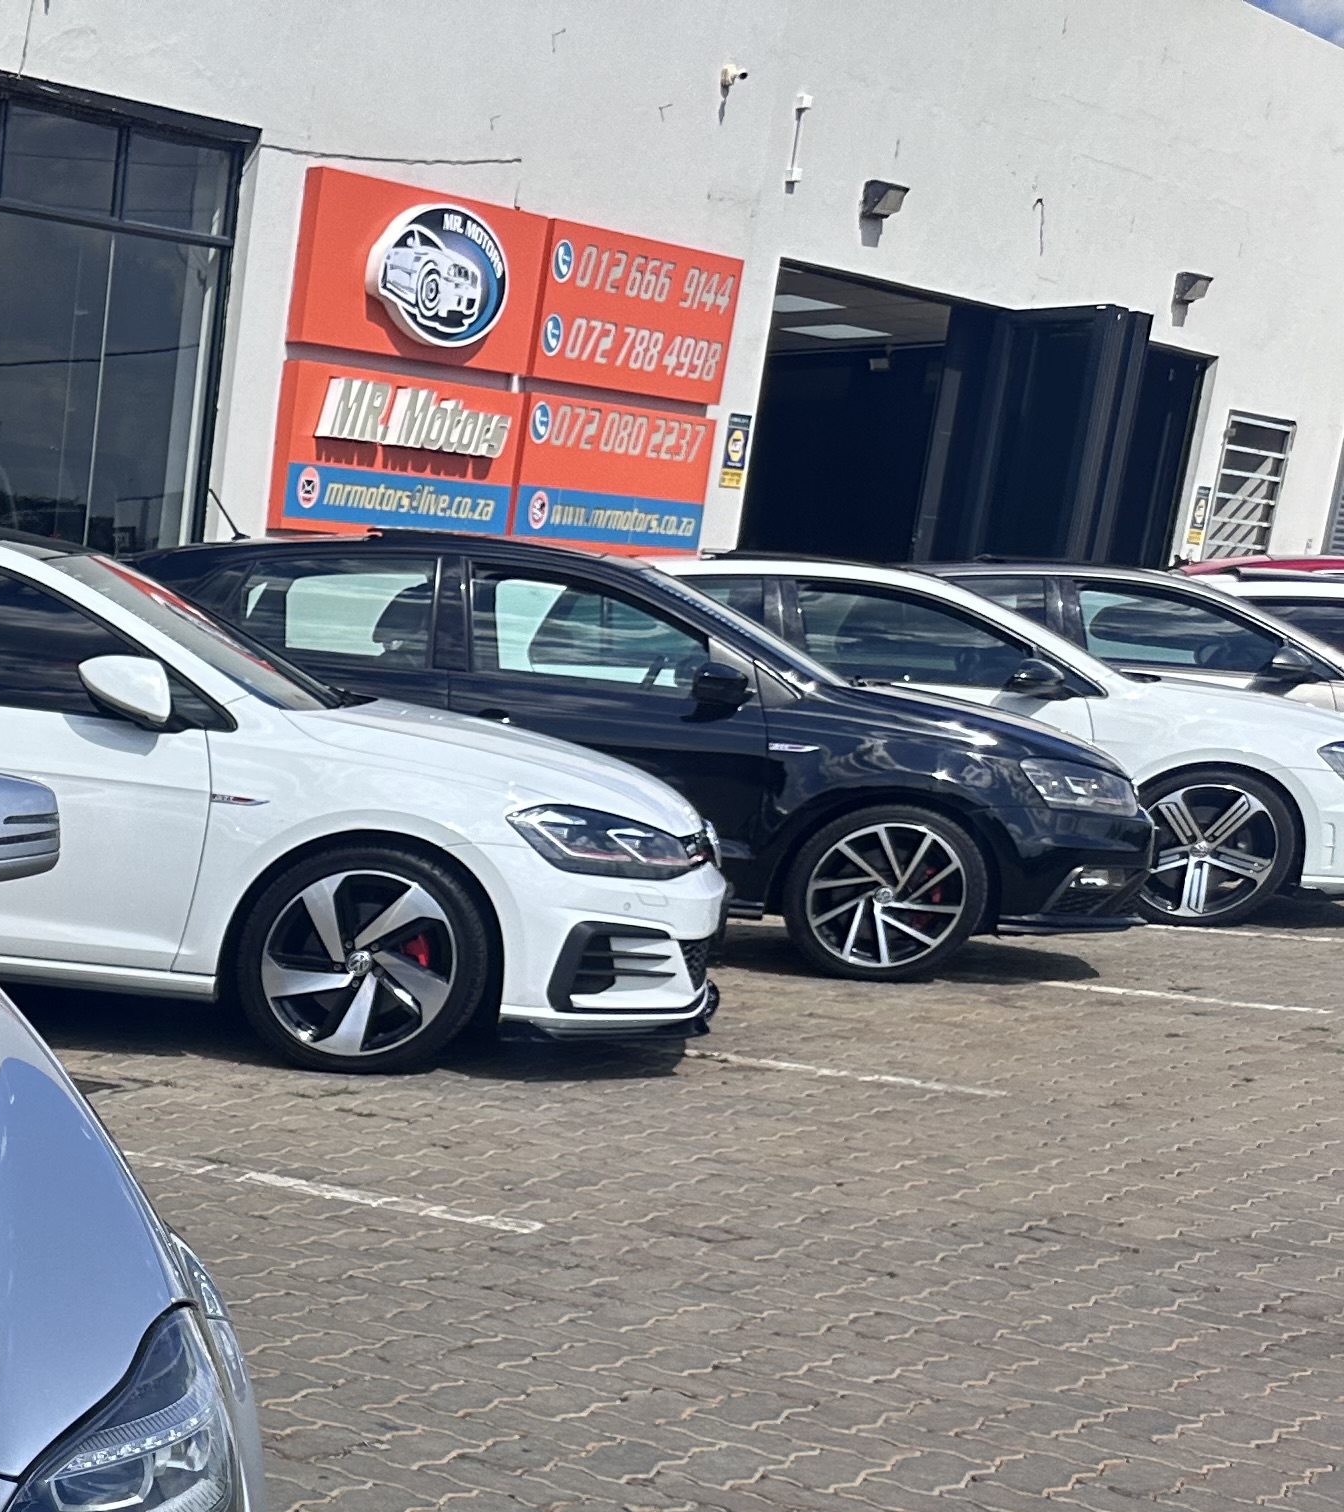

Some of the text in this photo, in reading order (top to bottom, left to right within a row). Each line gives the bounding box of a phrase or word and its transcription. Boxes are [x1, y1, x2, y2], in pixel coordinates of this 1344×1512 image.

[443, 214, 502, 278] MR. MOTORS
[576, 244, 735, 314] 012 666 9144
[565, 317, 722, 381] 072 788 4998
[316, 378, 512, 458] MR. Motors
[550, 405, 707, 463] 072 080 2237
[323, 482, 495, 520] mrmotors@live.co.za
[550, 504, 695, 537] www.mrmotors.co.za
